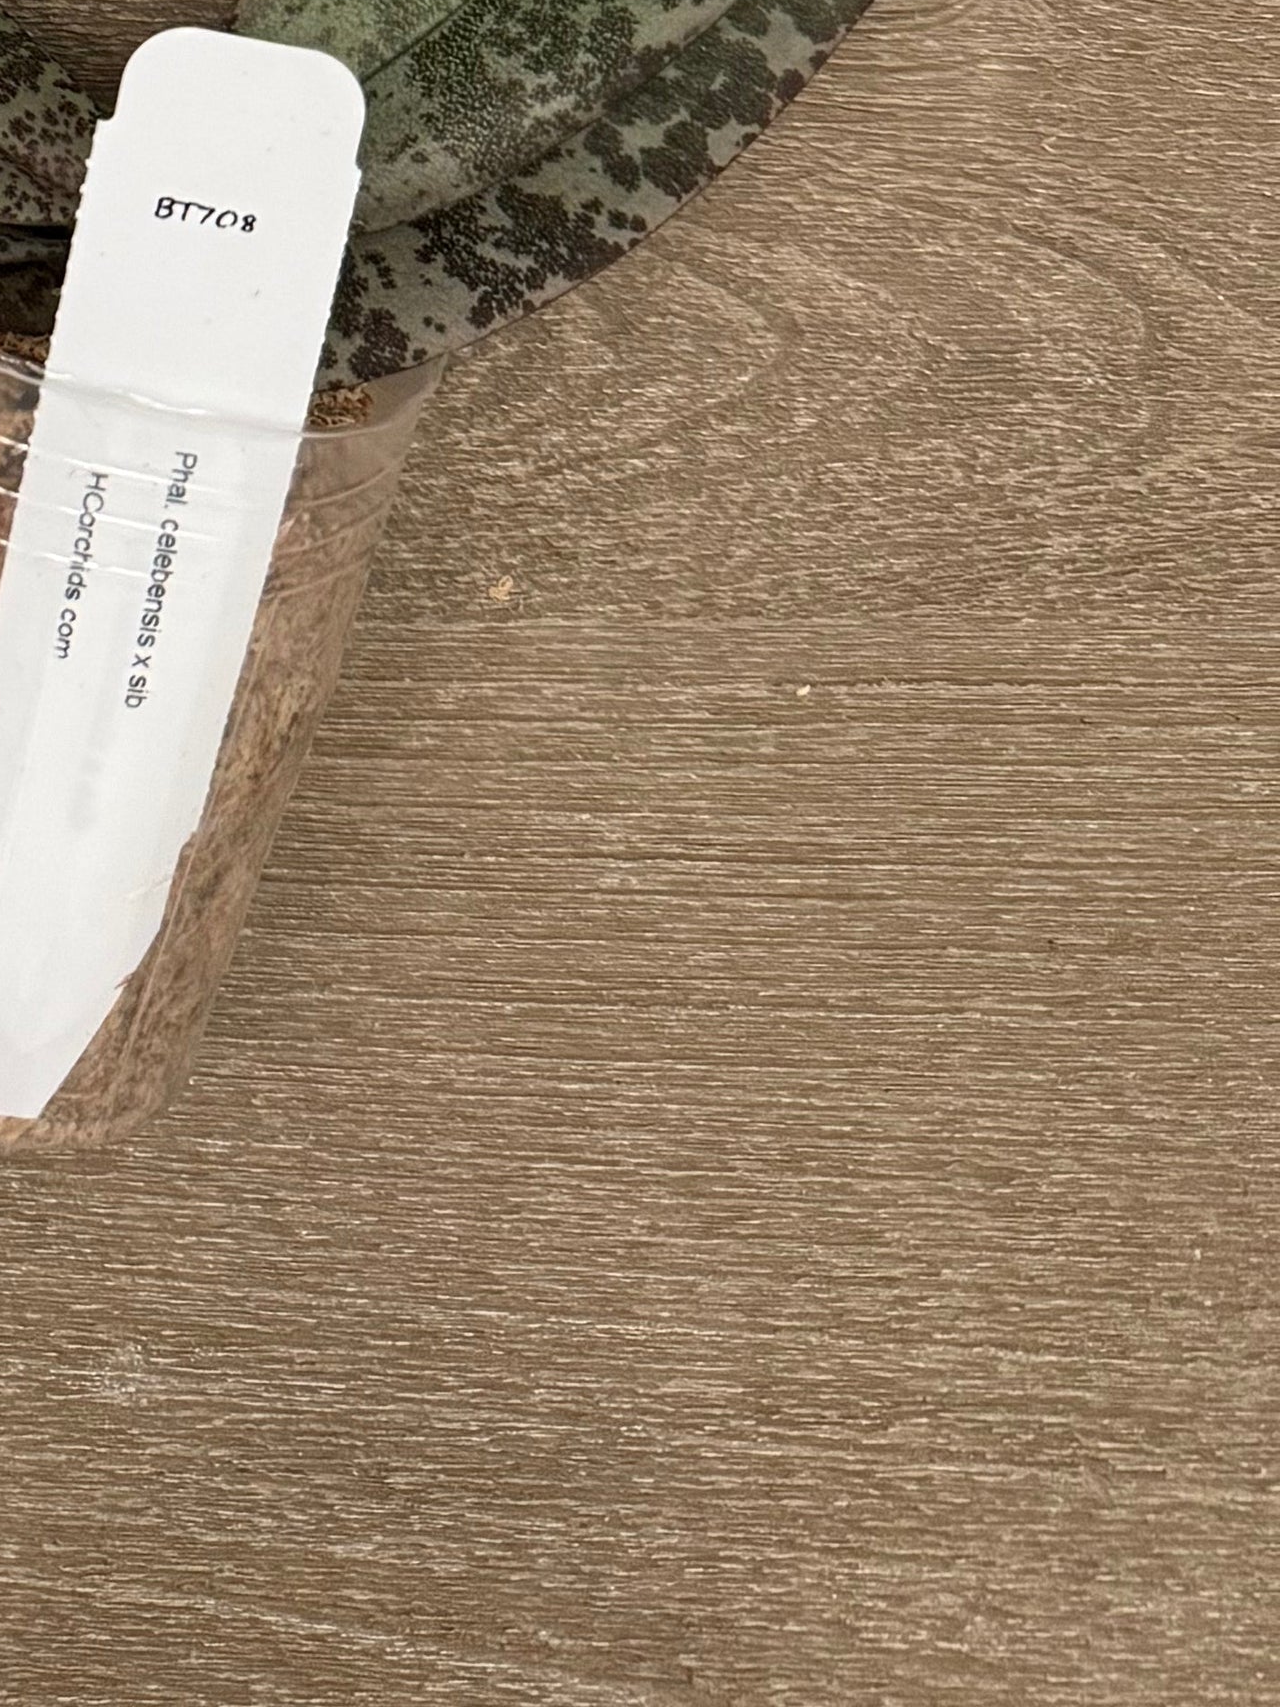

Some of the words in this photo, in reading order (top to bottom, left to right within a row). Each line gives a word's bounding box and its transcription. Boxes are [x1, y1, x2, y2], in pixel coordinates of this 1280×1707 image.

[154, 196, 257, 233] BT708
[136, 518, 180, 648] celebensis
[124, 673, 151, 709] sib
